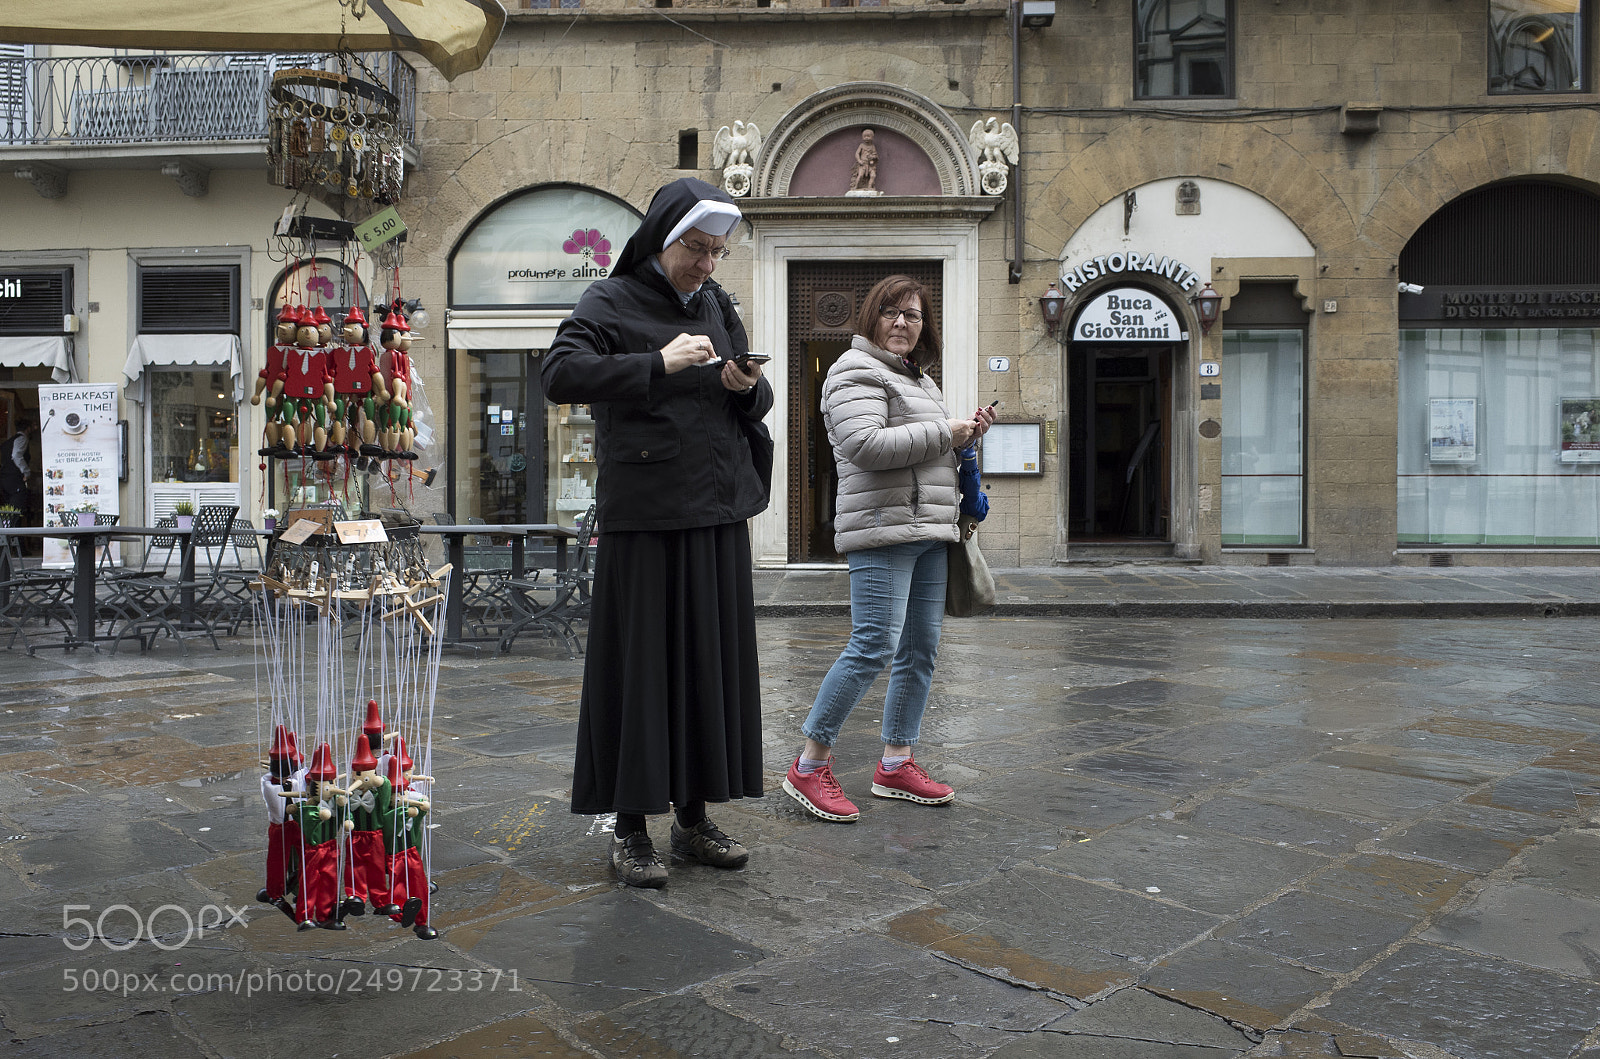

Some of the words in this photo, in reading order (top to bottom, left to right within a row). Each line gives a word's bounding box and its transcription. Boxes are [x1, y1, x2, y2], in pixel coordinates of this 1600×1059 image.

[363, 232, 372, 242] €
[373, 218, 396, 237] 5,00
[508, 268, 566, 279] profumerie
[572, 263, 608, 278] aline
[1061, 250, 1200, 293] RISTORANTE
[1107, 295, 1152, 310] Buca
[1445, 292, 1509, 304] MONTE
[1514, 292, 1545, 304] DEI
[1110, 311, 1144, 326] San
[1445, 305, 1464, 318] DI
[1469, 305, 1520, 318] SIENA
[1527, 308, 1564, 317] BANCA
[1567, 308, 1590, 317] DAL
[1080, 323, 1170, 339] Giovanni
[996, 359, 1002, 369] 7
[1206, 365, 1213, 374] 8
[52, 391, 115, 401] BREAKFAST
[84, 403, 112, 411] TIME!
